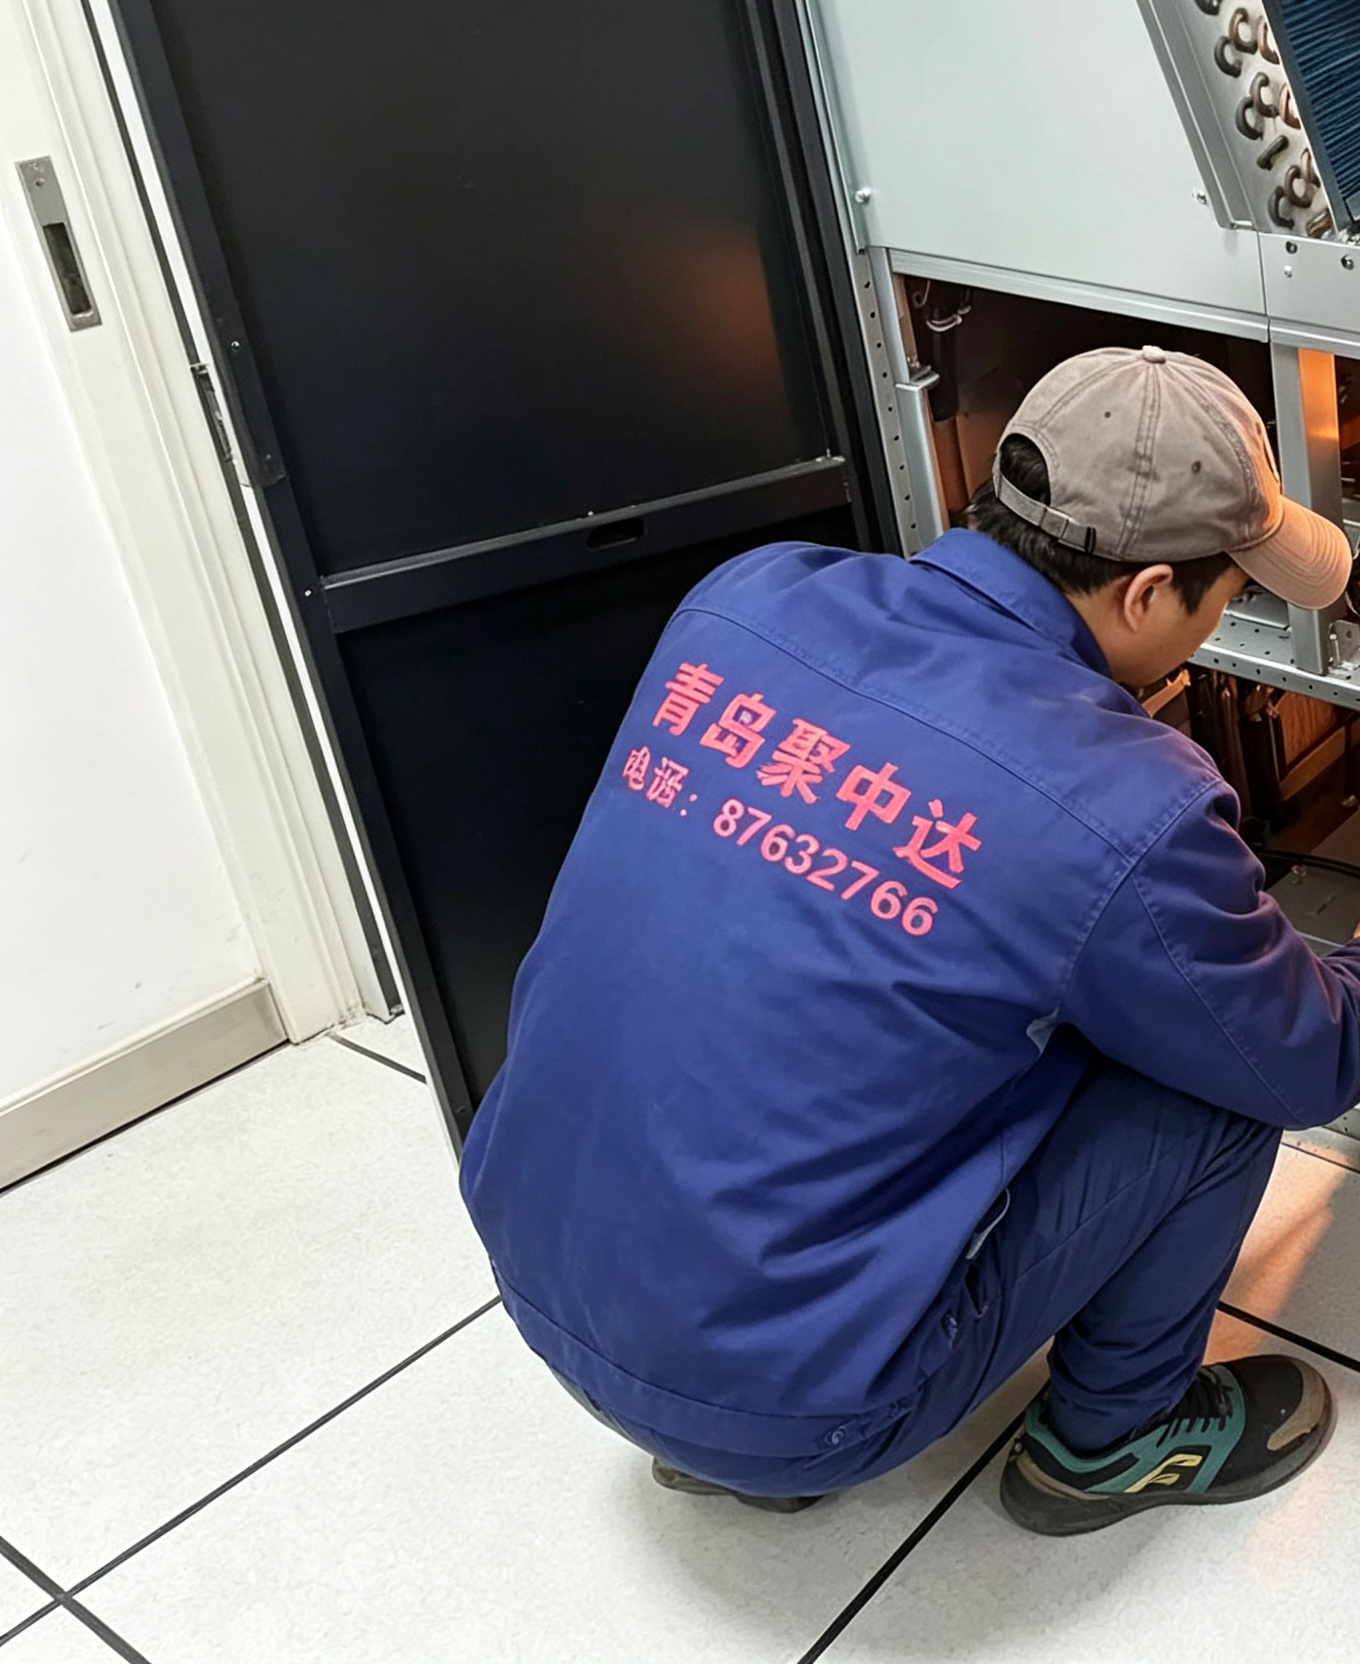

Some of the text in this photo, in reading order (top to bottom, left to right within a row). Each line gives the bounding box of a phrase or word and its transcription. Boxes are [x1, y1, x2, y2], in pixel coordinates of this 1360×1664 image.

[652, 662, 982, 890] 青岛聚中达
